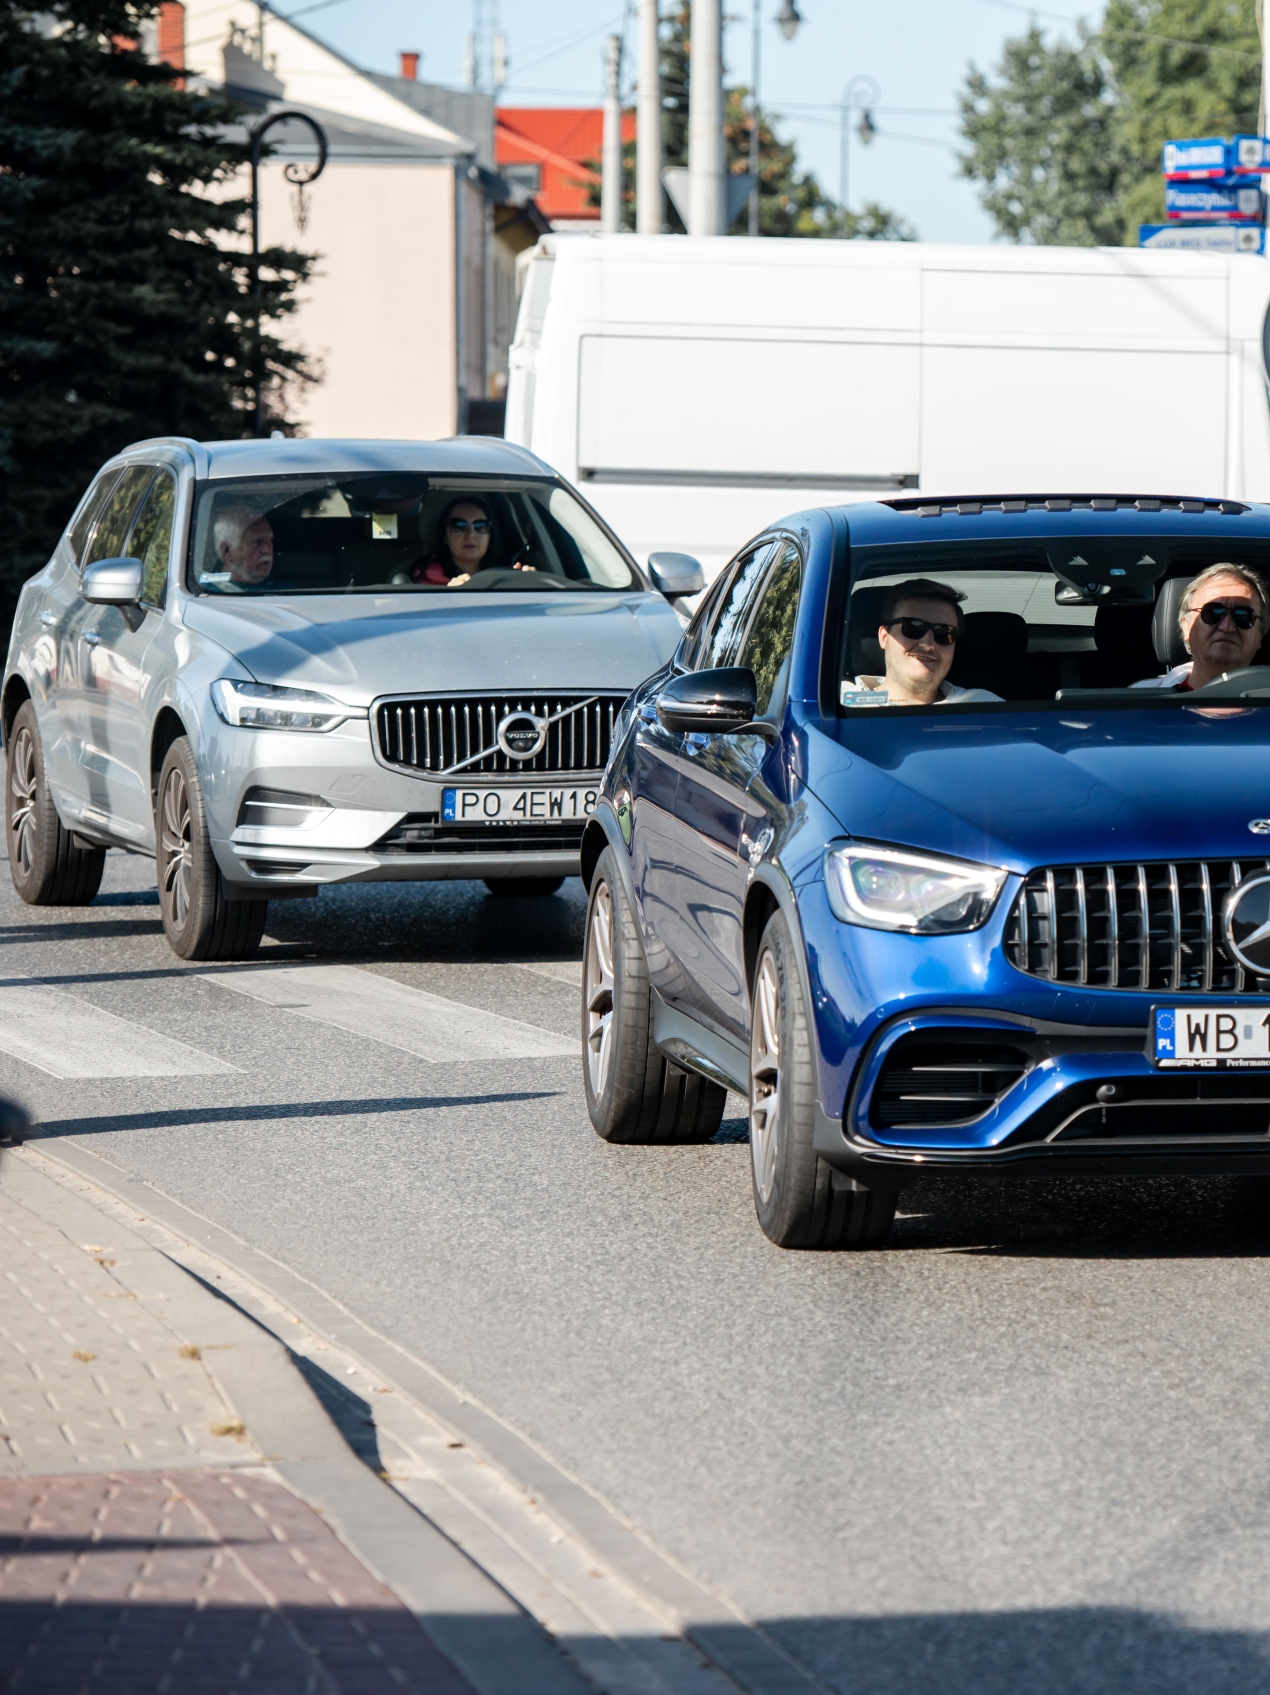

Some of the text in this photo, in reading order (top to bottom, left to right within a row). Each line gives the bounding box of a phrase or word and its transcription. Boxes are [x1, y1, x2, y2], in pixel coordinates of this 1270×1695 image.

[461, 790, 597, 818] PO 4EW18
[444, 809, 454, 817] PL
[1186, 1013, 1238, 1052] WB
[1158, 1039, 1173, 1051] PL
[1178, 1059, 1217, 1067] AMG
